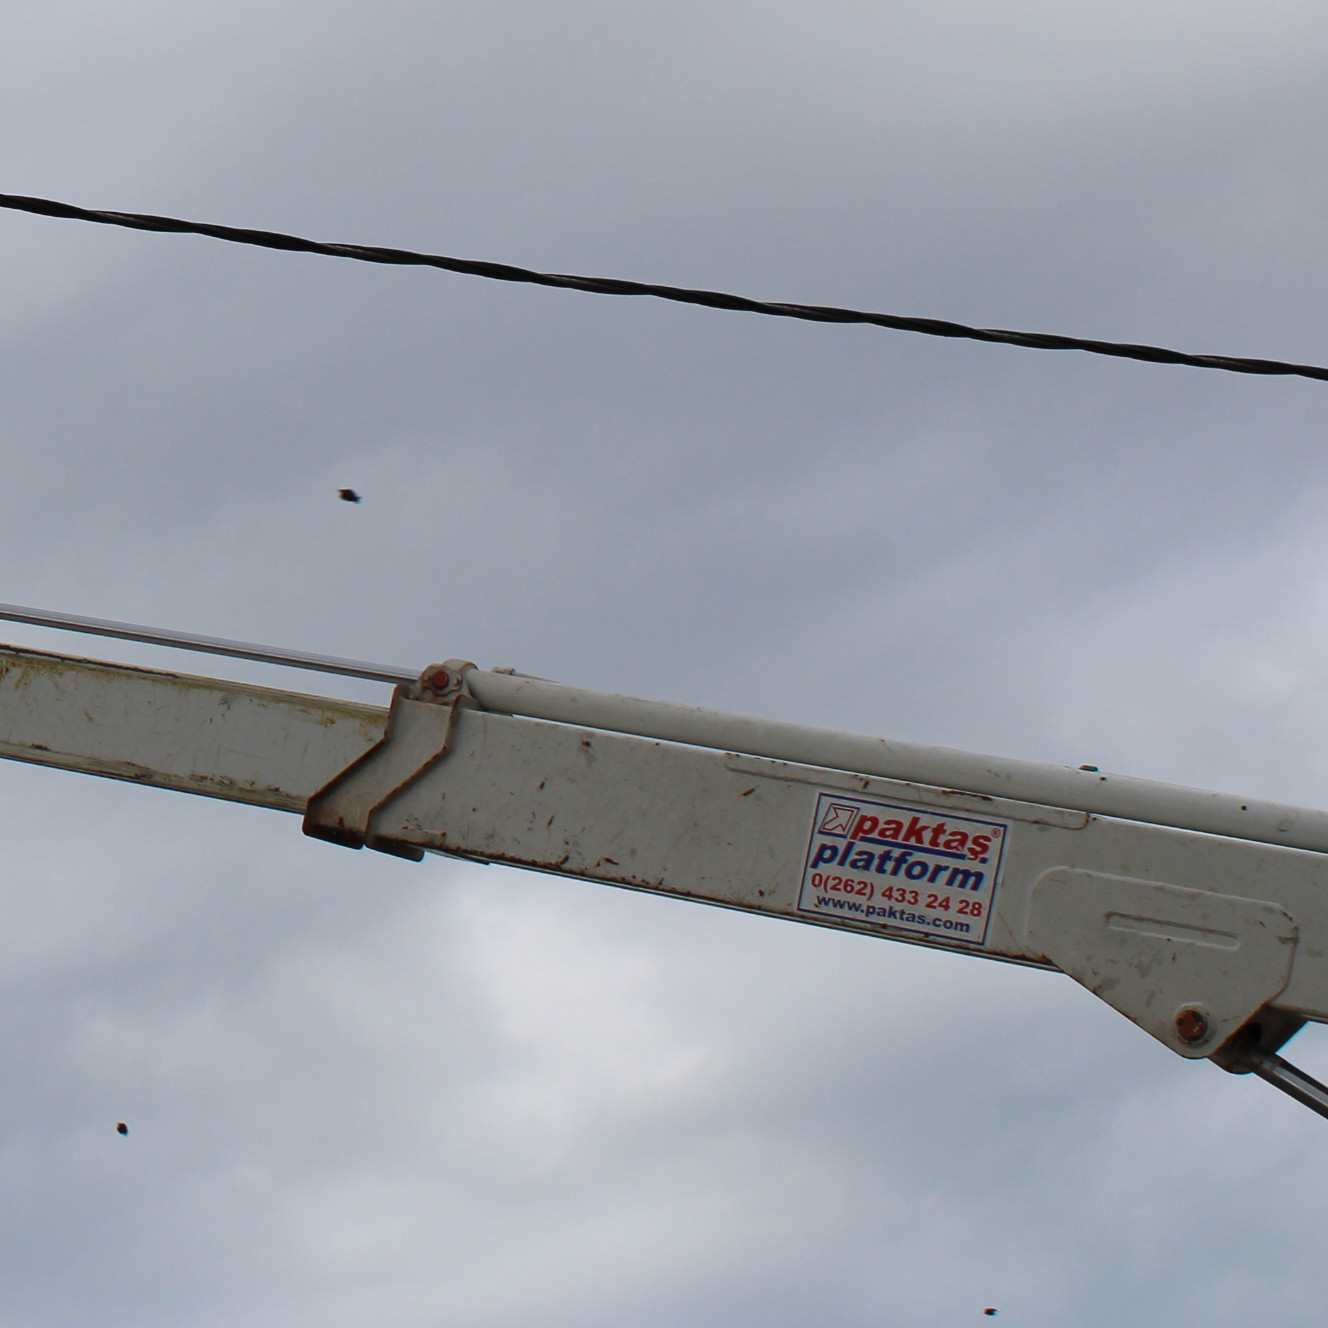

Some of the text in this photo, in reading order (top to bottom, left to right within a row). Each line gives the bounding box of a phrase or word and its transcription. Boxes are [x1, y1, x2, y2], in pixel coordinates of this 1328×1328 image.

[810, 841, 986, 891] platform
[811, 872, 983, 917] 0(262) 433 24 28
[816, 894, 970, 933] www.paktas.com
